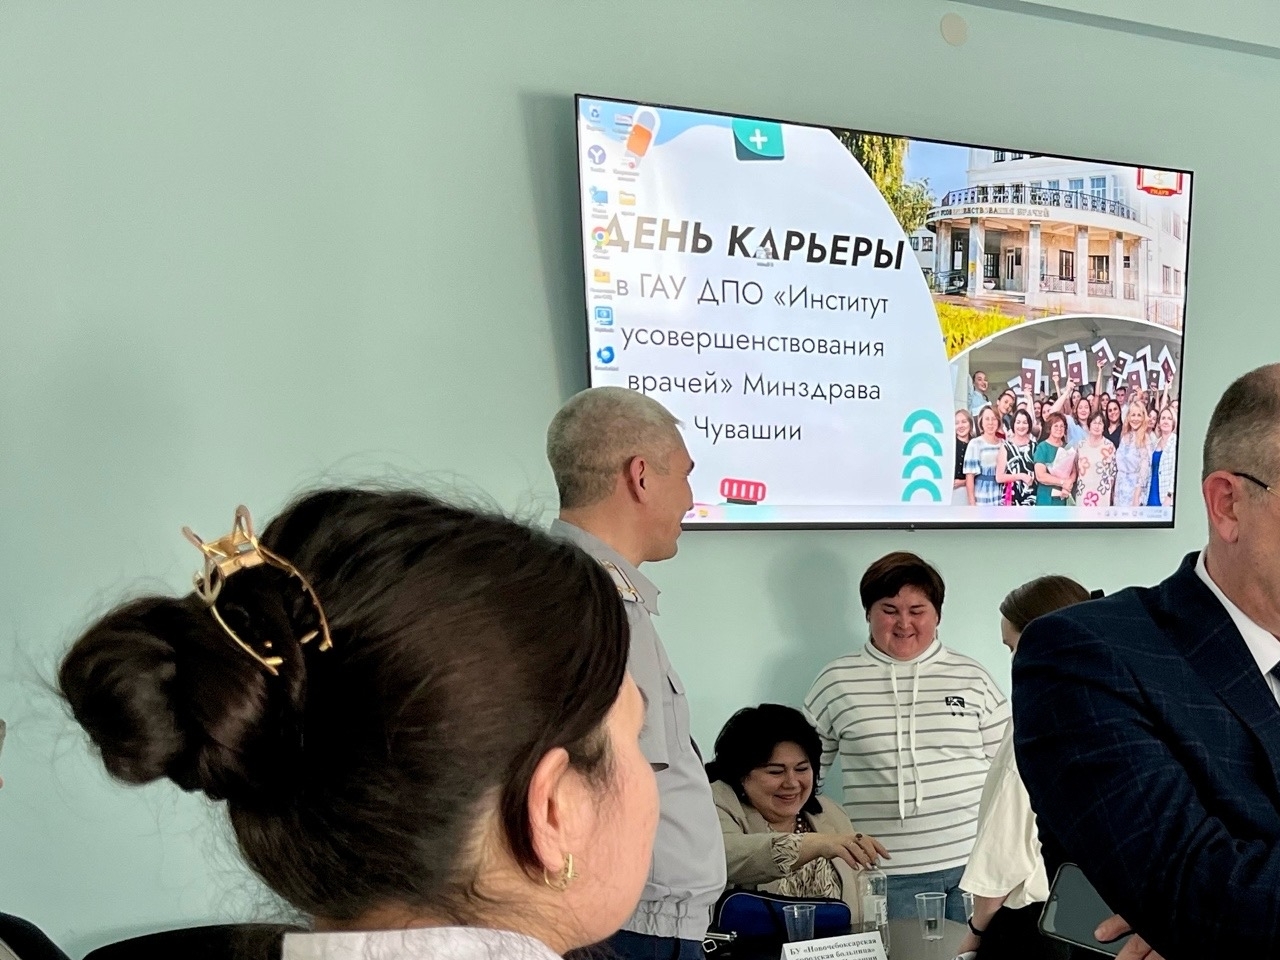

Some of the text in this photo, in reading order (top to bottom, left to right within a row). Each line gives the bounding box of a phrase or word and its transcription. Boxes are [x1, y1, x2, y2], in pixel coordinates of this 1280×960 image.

[605, 213, 905, 271] ДЕНЬ КАРЬЕРЫ
[616, 279, 629, 297] в
[640, 273, 687, 300] ГАУ
[697, 278, 763, 306] ДПО
[774, 284, 889, 319] «Институт
[620, 326, 885, 357] усовершенствования
[627, 370, 881, 404] врачей» Минздрава
[694, 415, 802, 445] Чувашии
[789, 938, 877, 956] БУ «Новочебоксарская
[835, 947, 876, 958] больница»
